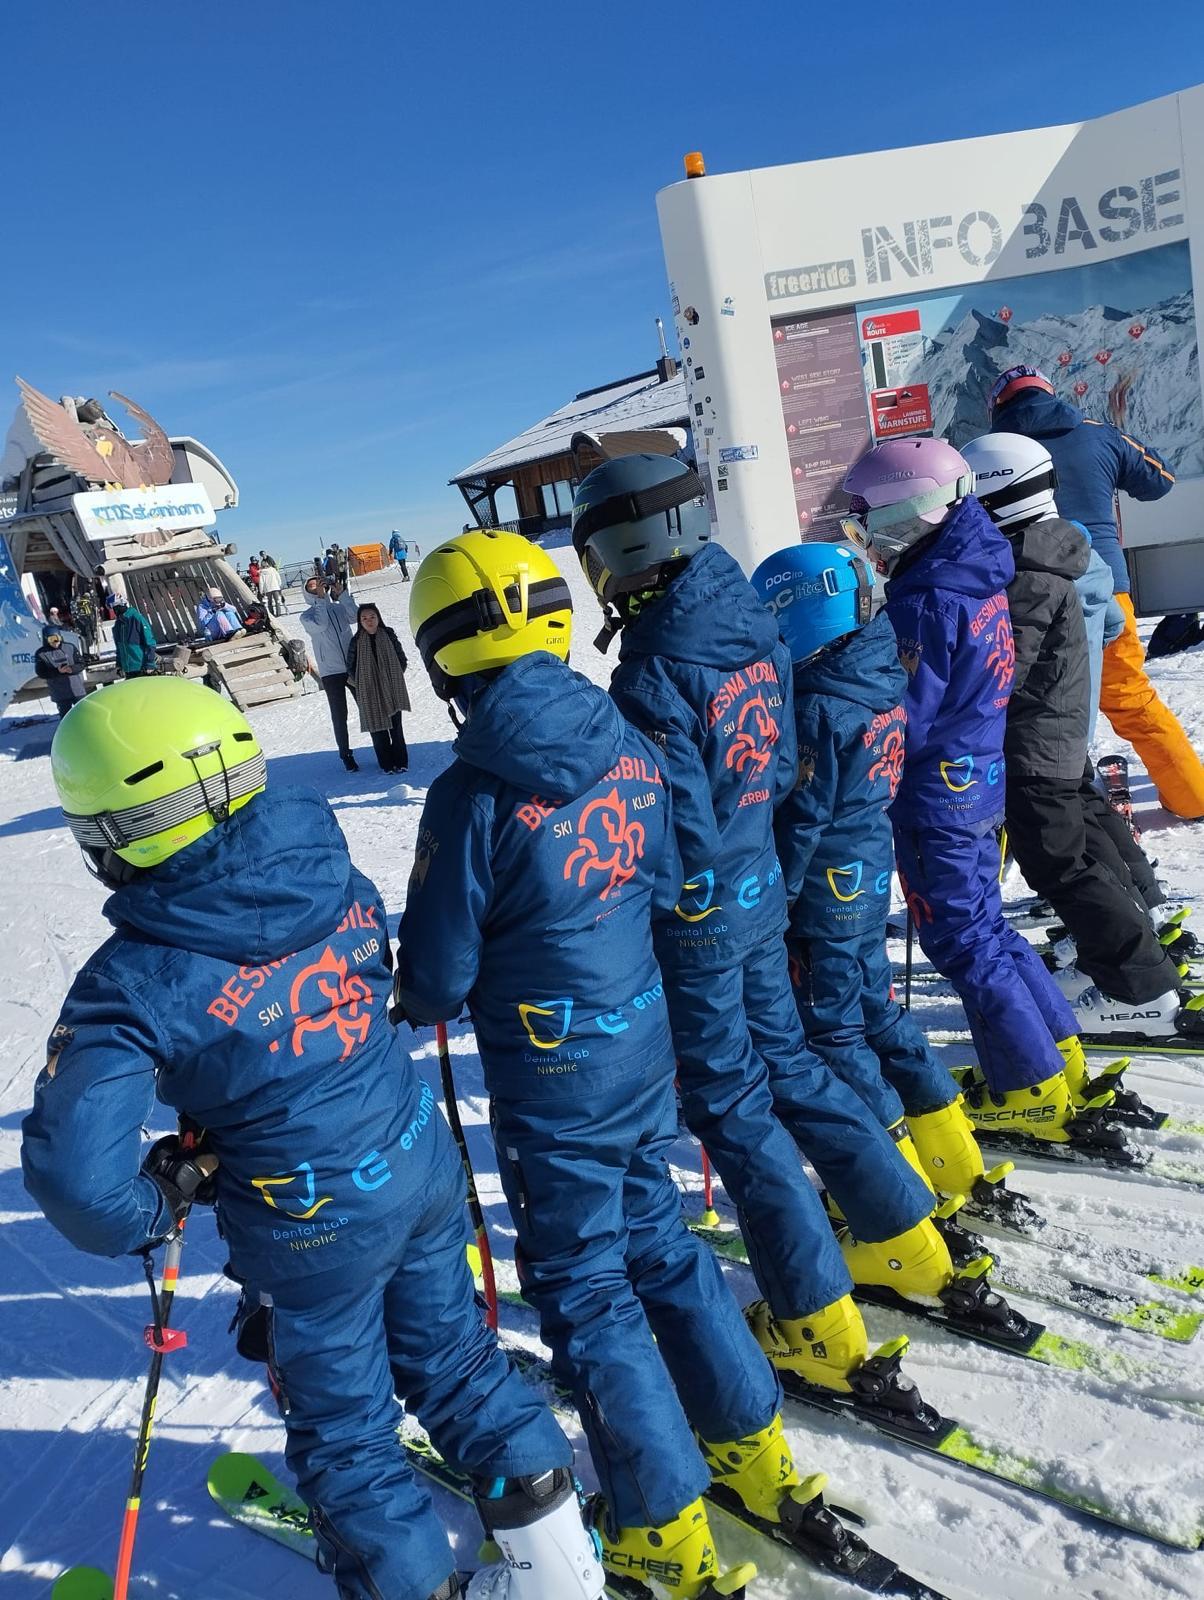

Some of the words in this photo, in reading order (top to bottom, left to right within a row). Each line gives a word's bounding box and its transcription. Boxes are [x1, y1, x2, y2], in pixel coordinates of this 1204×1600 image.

[861, 210, 1002, 285] INFO
[1021, 167, 1185, 260] BASE
[769, 264, 850, 297] freeride
[867, 328, 887, 337] ROUTE
[878, 414, 928, 430] WARNSTUFE
[632, 791, 657, 812] KLUB
[553, 819, 573, 839] SKI
[855, 903, 869, 911] Lab
[708, 924, 728, 935] Lab
[352, 937, 380, 965] KLUB
[258, 1002, 284, 1028] SKI
[1100, 1010, 1162, 1022] HEAD
[568, 1048, 590, 1061] Lab
[537, 1063, 579, 1076] Nikolić
[968, 1104, 1057, 1122] FISCHER
[272, 1225, 317, 1241] Dental
[323, 1217, 349, 1231] Lab
[290, 1231, 338, 1252] Nikolić
